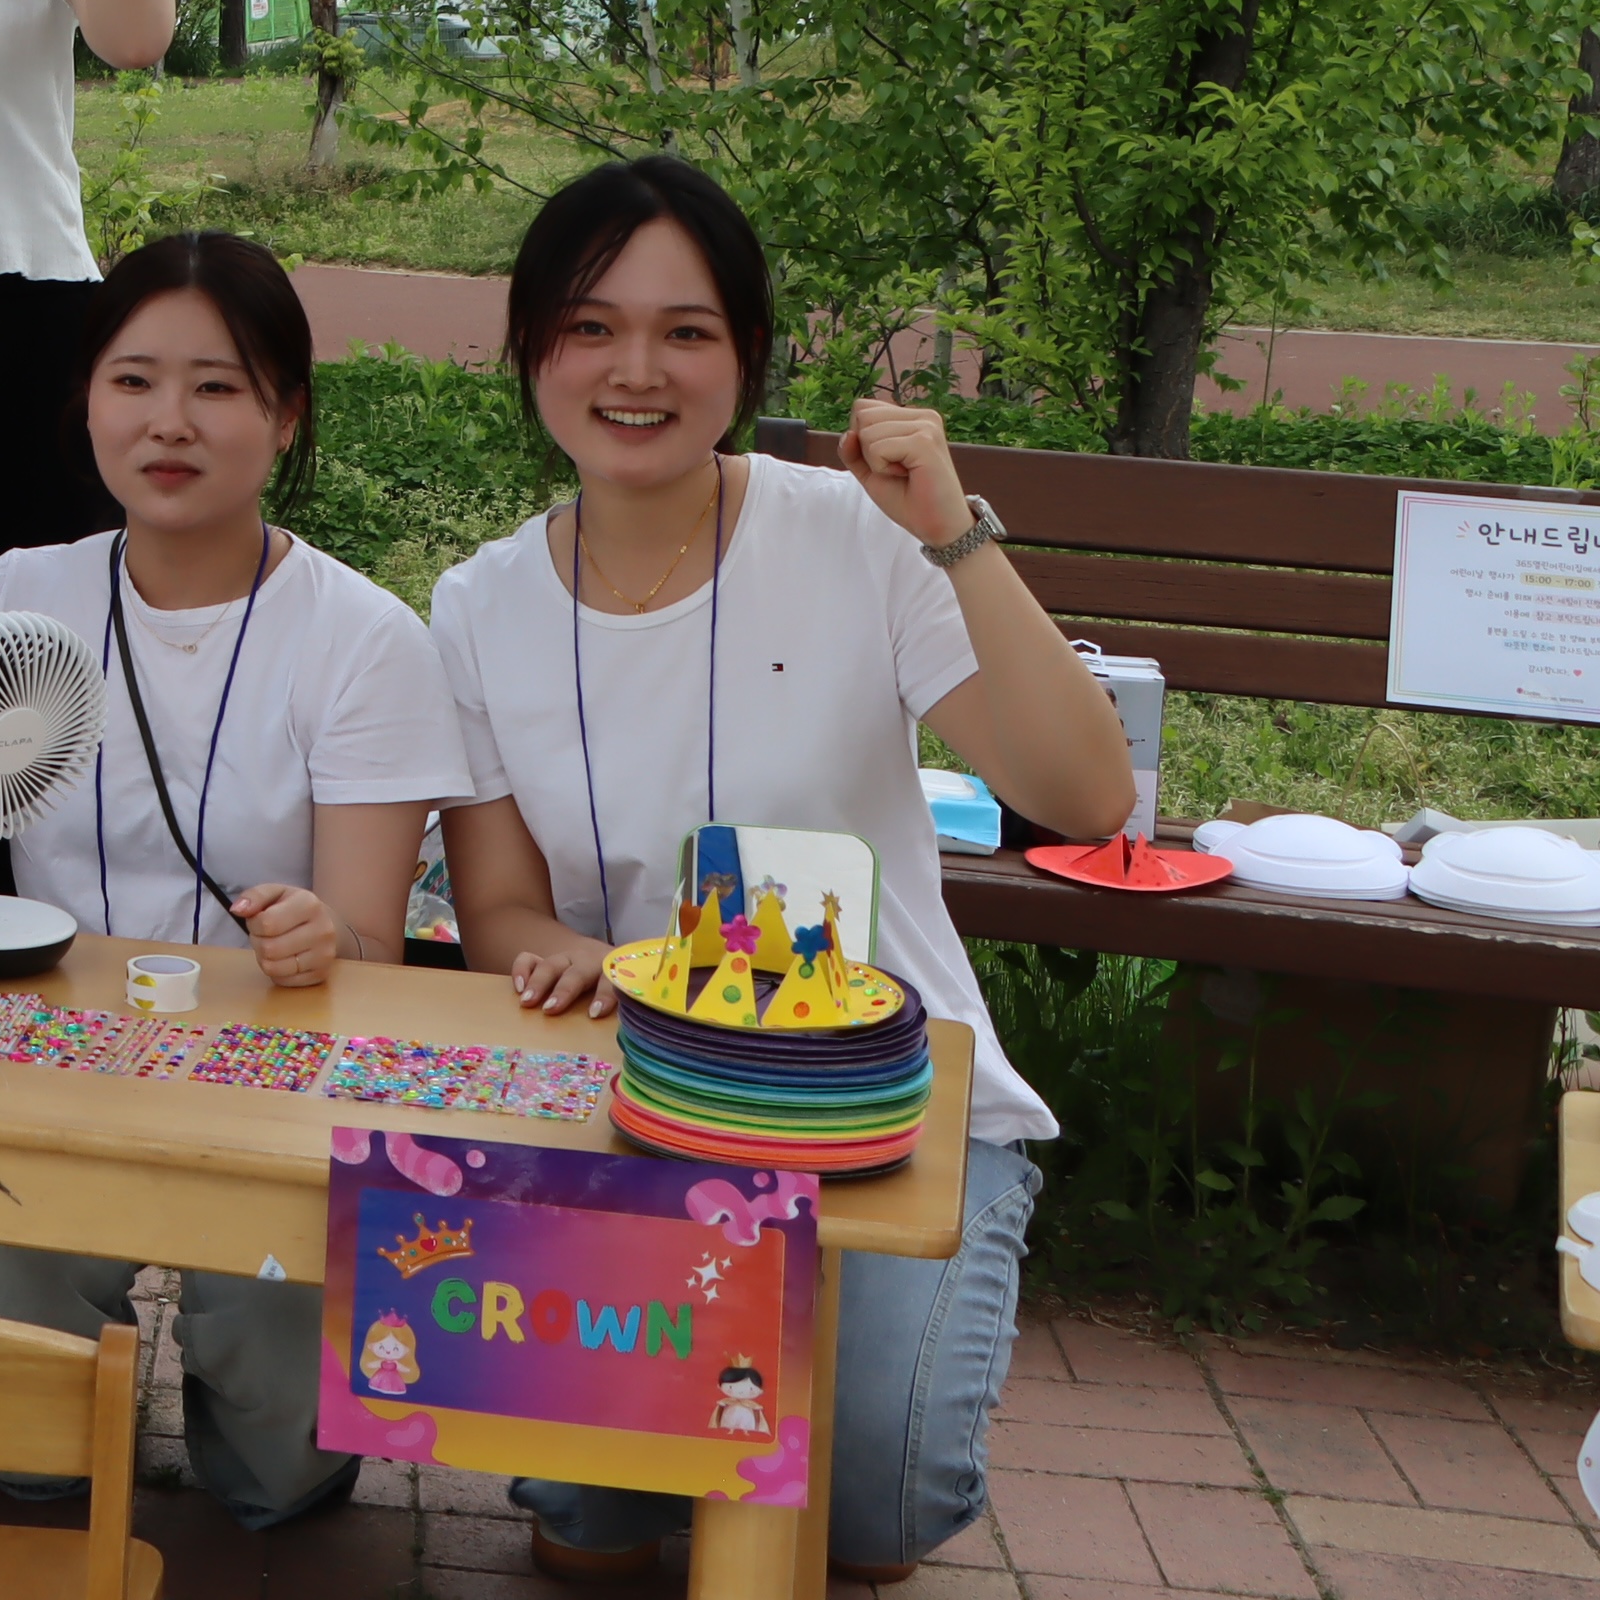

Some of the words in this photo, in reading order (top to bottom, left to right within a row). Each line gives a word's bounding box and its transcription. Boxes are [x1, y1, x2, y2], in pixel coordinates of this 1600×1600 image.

[1525, 574, 1552, 585] 15:00
[1565, 578, 1591, 588] 17:00
[431, 1277, 693, 1359] CROWN
